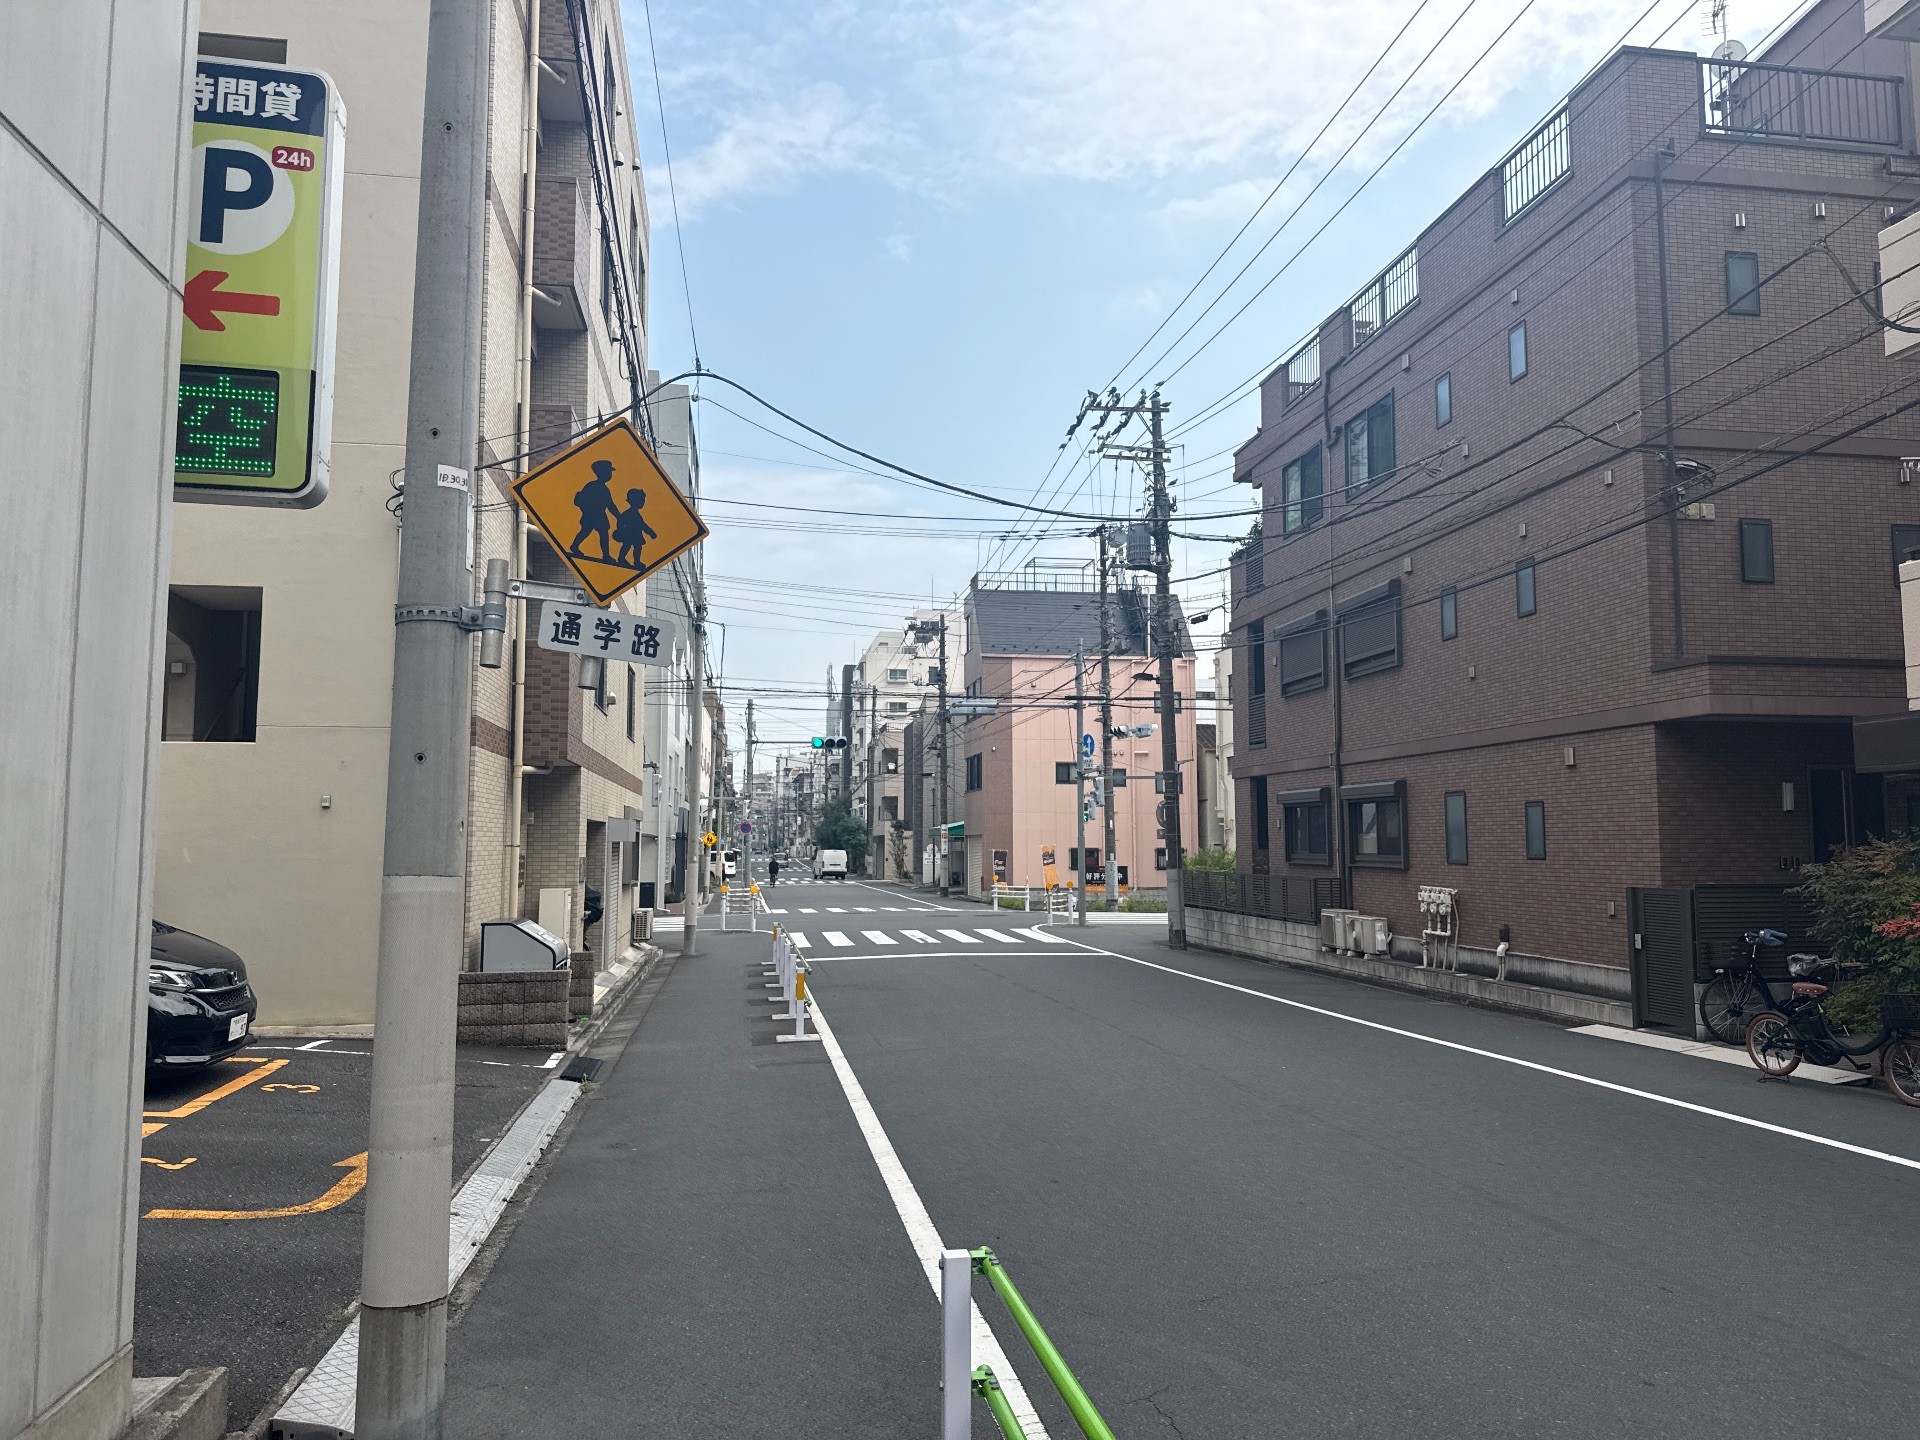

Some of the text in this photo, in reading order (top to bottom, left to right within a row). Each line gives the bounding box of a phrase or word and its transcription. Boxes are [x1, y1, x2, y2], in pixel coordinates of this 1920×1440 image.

[277, 149, 311, 168] 24h
[199, 146, 274, 244] P
[174, 375, 276, 473] 空
[549, 609, 662, 660] 通学路
[1085, 872, 1123, 881] 好評分中
